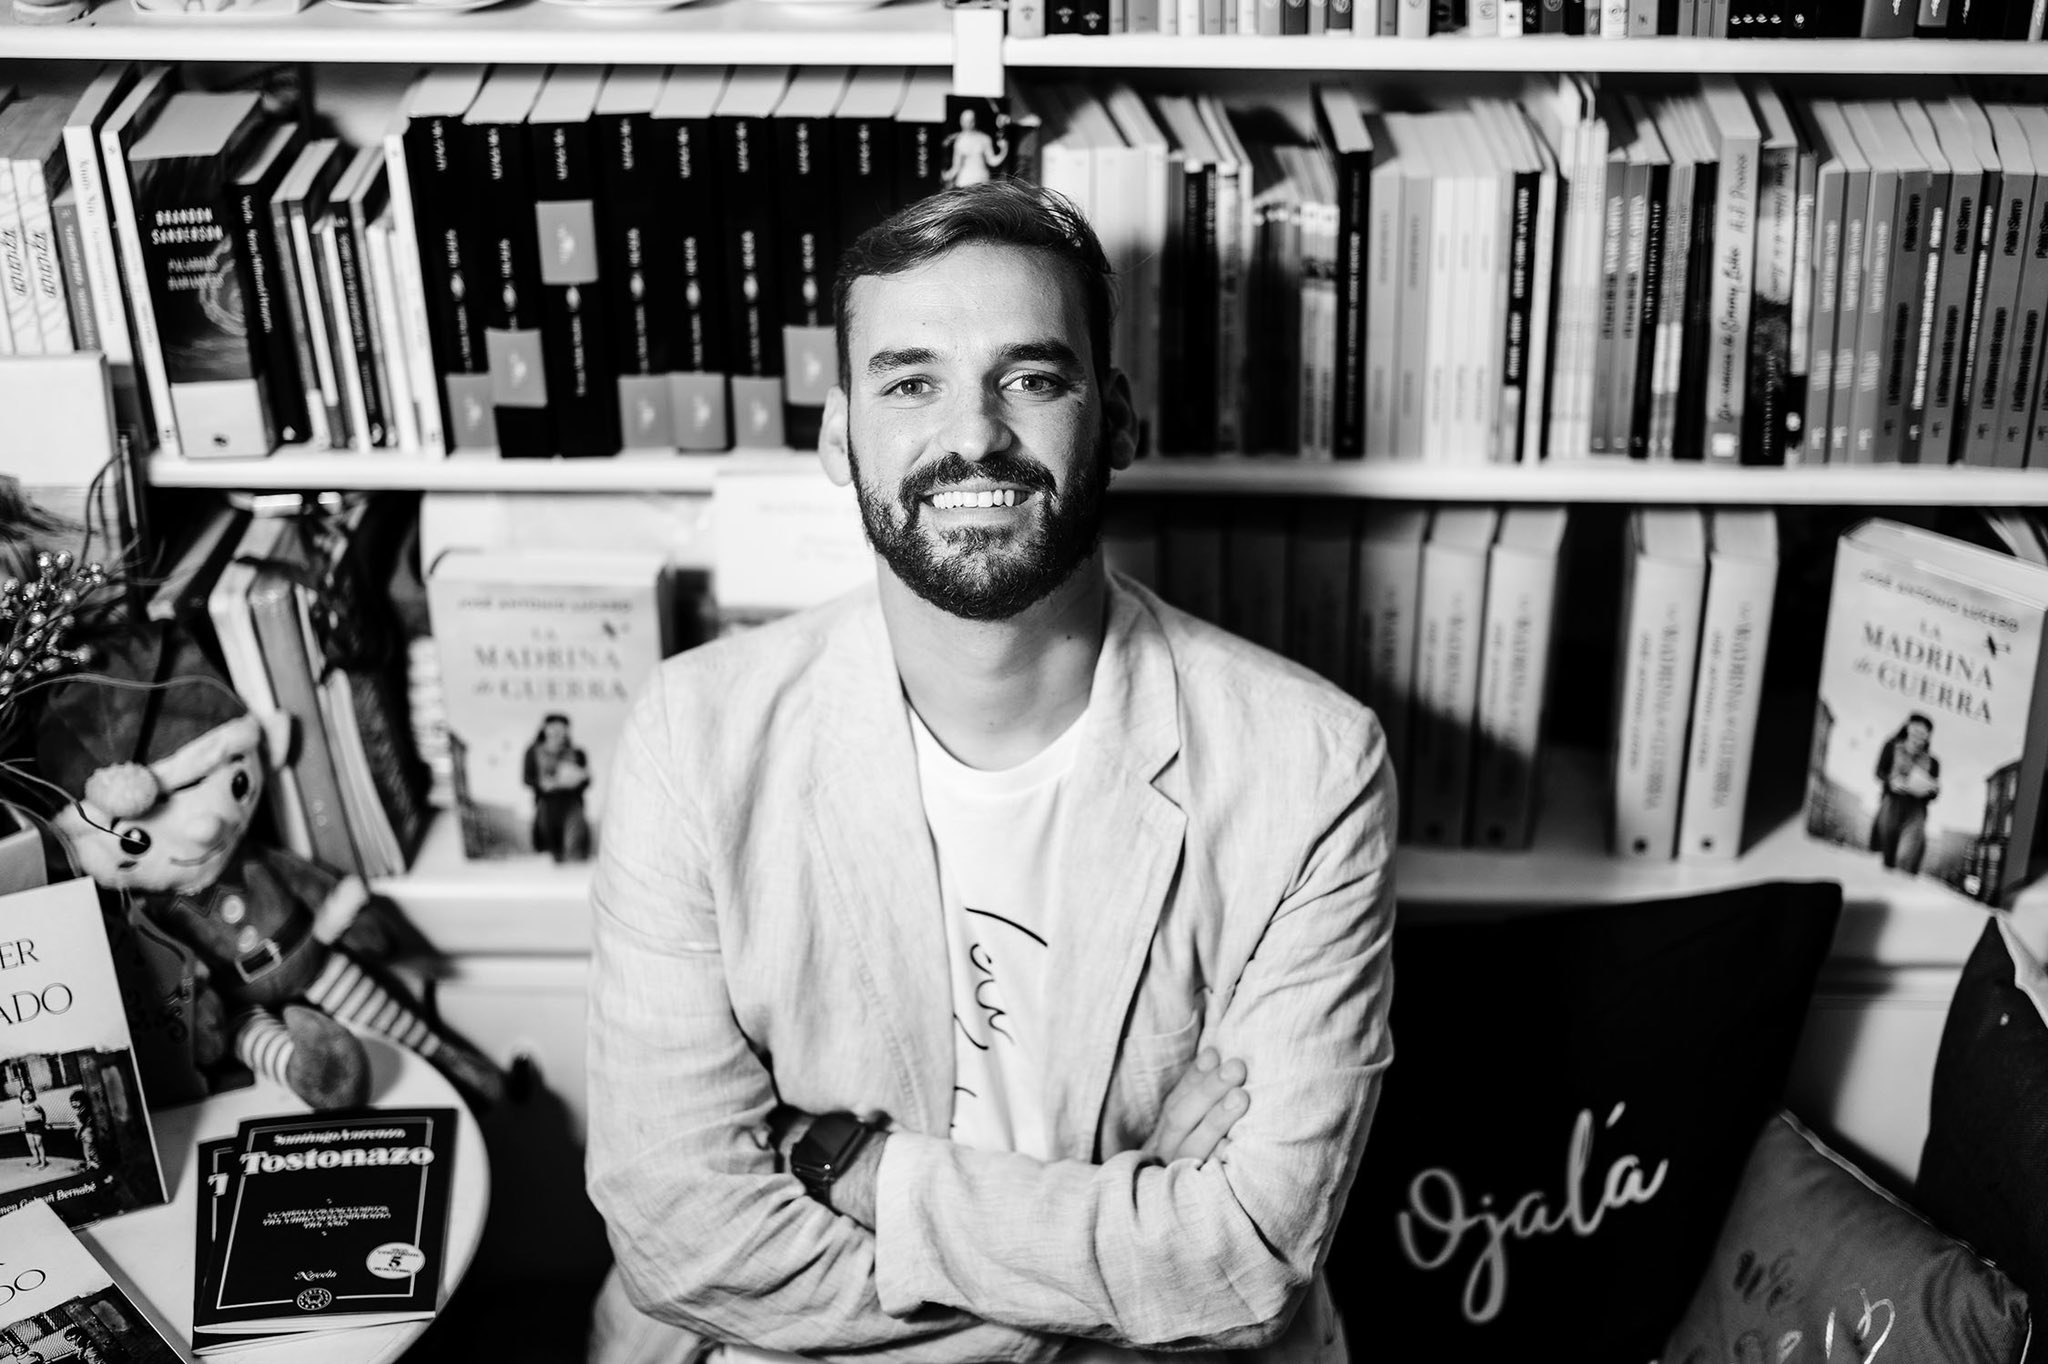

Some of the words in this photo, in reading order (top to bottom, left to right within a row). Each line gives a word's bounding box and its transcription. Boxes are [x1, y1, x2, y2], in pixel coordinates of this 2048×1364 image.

[151, 225, 224, 245] SANDERSON
[474, 643, 622, 670] MADRINA
[1863, 620, 1996, 693] MADRINA
[498, 677, 629, 704] GUERRA
[1875, 660, 1993, 725] GUERRA
[240, 1143, 434, 1176] Tostonazo
[57, 1180, 97, 1204] Bernabé
[1398, 1101, 1669, 1324] Ojalá
[388, 1256, 402, 1268] 5
